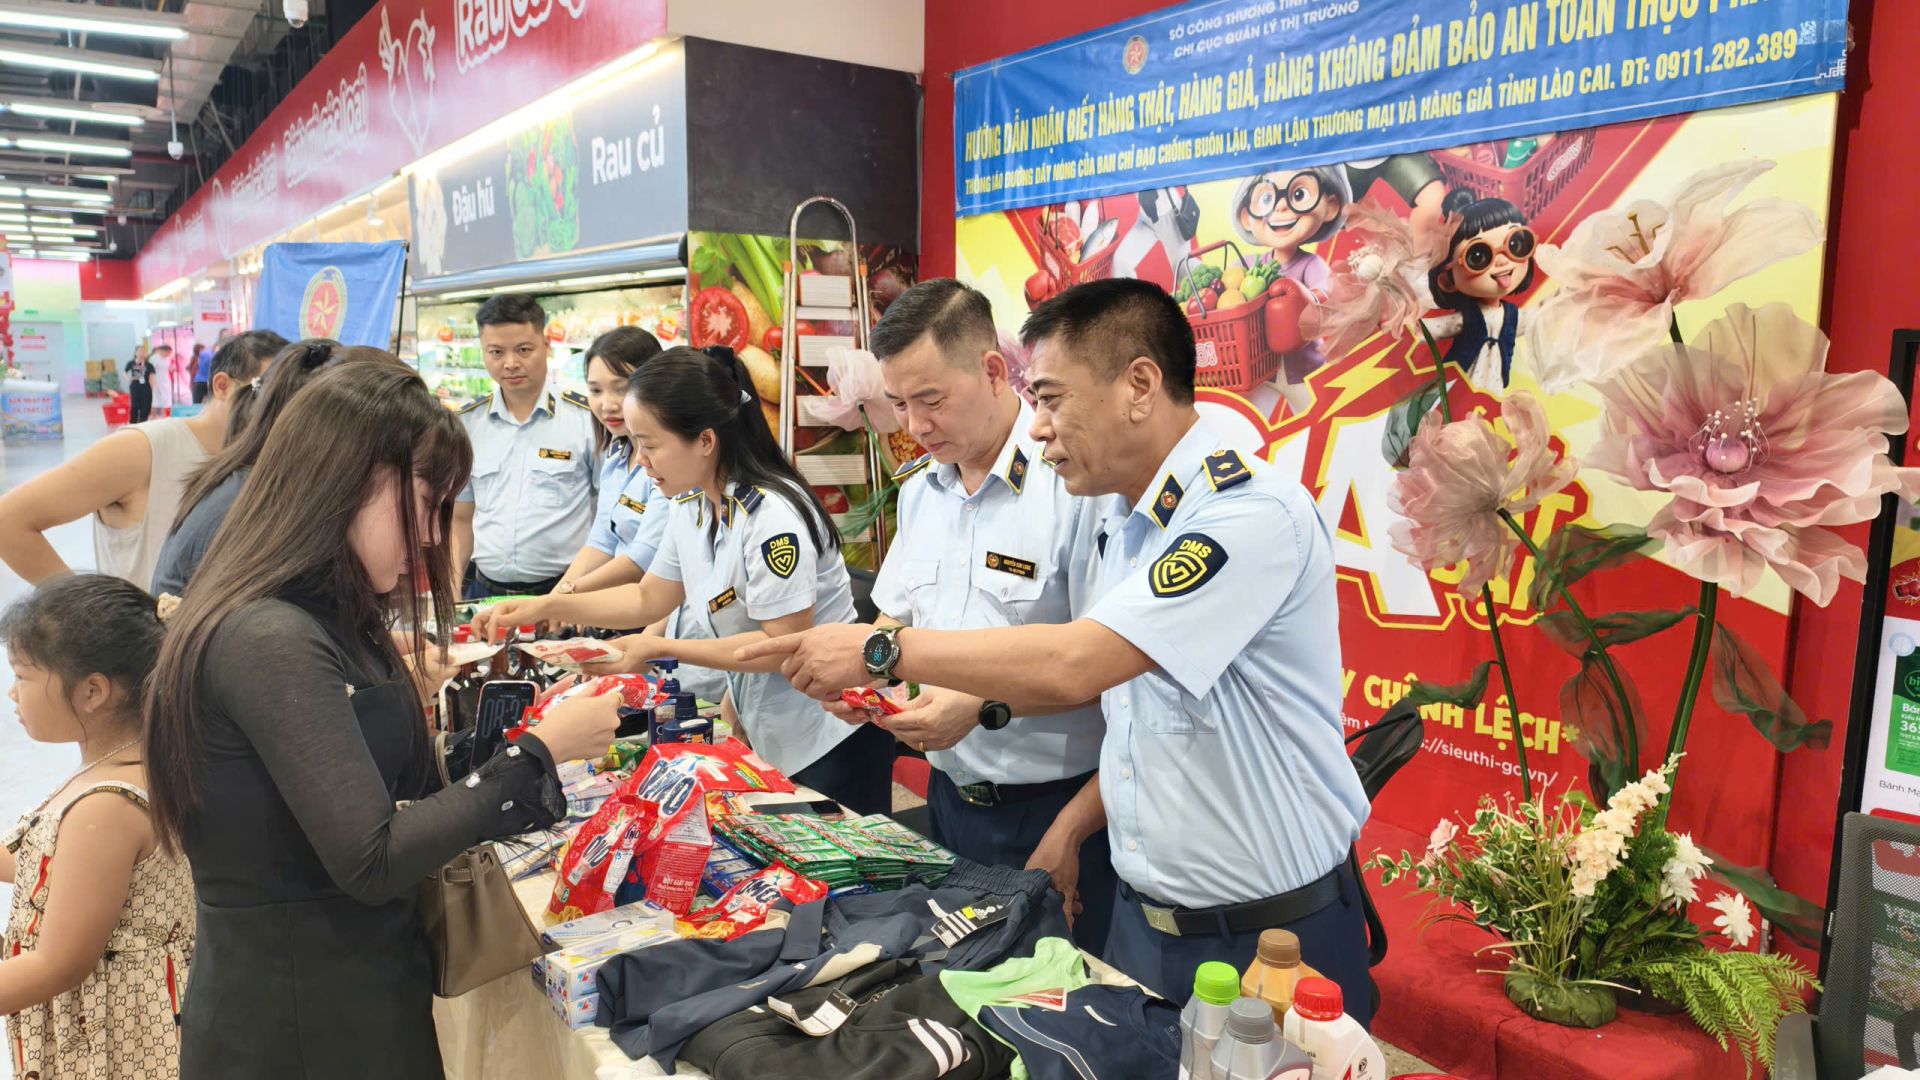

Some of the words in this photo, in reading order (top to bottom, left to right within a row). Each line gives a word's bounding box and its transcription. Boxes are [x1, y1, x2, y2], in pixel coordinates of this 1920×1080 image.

[1169, 24, 1185, 41] SỞ
[1187, 16, 1222, 35] CÔNG
[1225, 3, 1276, 25] THƯƠNG
[1174, 43, 1194, 58] CHI
[1225, 25, 1261, 44] QUẢN
[1263, 19, 1278, 36] LÝ
[1303, 0, 1360, 25] TRƯỜNG
[1031, 106, 1065, 154] NHẬN
[1067, 94, 1096, 144] BIẾT
[1098, 92, 1135, 137] HÀNG
[1138, 80, 1175, 134] THẬT,
[1178, 73, 1222, 120] HÀNG
[1226, 54, 1260, 112] GIẢ,
[1263, 52, 1314, 104] HÀNG
[1318, 36, 1385, 93] KHÔNG
[1390, 14, 1442, 77] ĐẢM
[1447, 0, 1497, 67] BẢO
[1501, 1, 1539, 56] AN
[1097, 154, 1116, 174] BAN
[1158, 135, 1192, 164] CHỐNG
[1194, 127, 1224, 158] BUÔN
[1253, 121, 1282, 149] GIAN
[1284, 115, 1309, 148] LẬN
[1312, 105, 1363, 134] THƯƠNG
[1366, 102, 1395, 133] MẠI
[1398, 91, 1417, 125] VÀ
[1420, 90, 1462, 121] HÀNG
[1466, 77, 1494, 113] GIẢ
[1498, 73, 1537, 108] TỈNH
[1540, 67, 1574, 101] LÀO
[1579, 63, 1615, 94] CAI.
[1621, 55, 1650, 86] ĐT:
[1655, 28, 1798, 82] 0911.282.389
[591, 136, 632, 185] Rau
[637, 105, 665, 172] củ
[452, 188, 477, 231] Đậu
[478, 175, 495, 218] hũ
[770, 536, 789, 549] DMS
[1179, 539, 1212, 558] DMS
